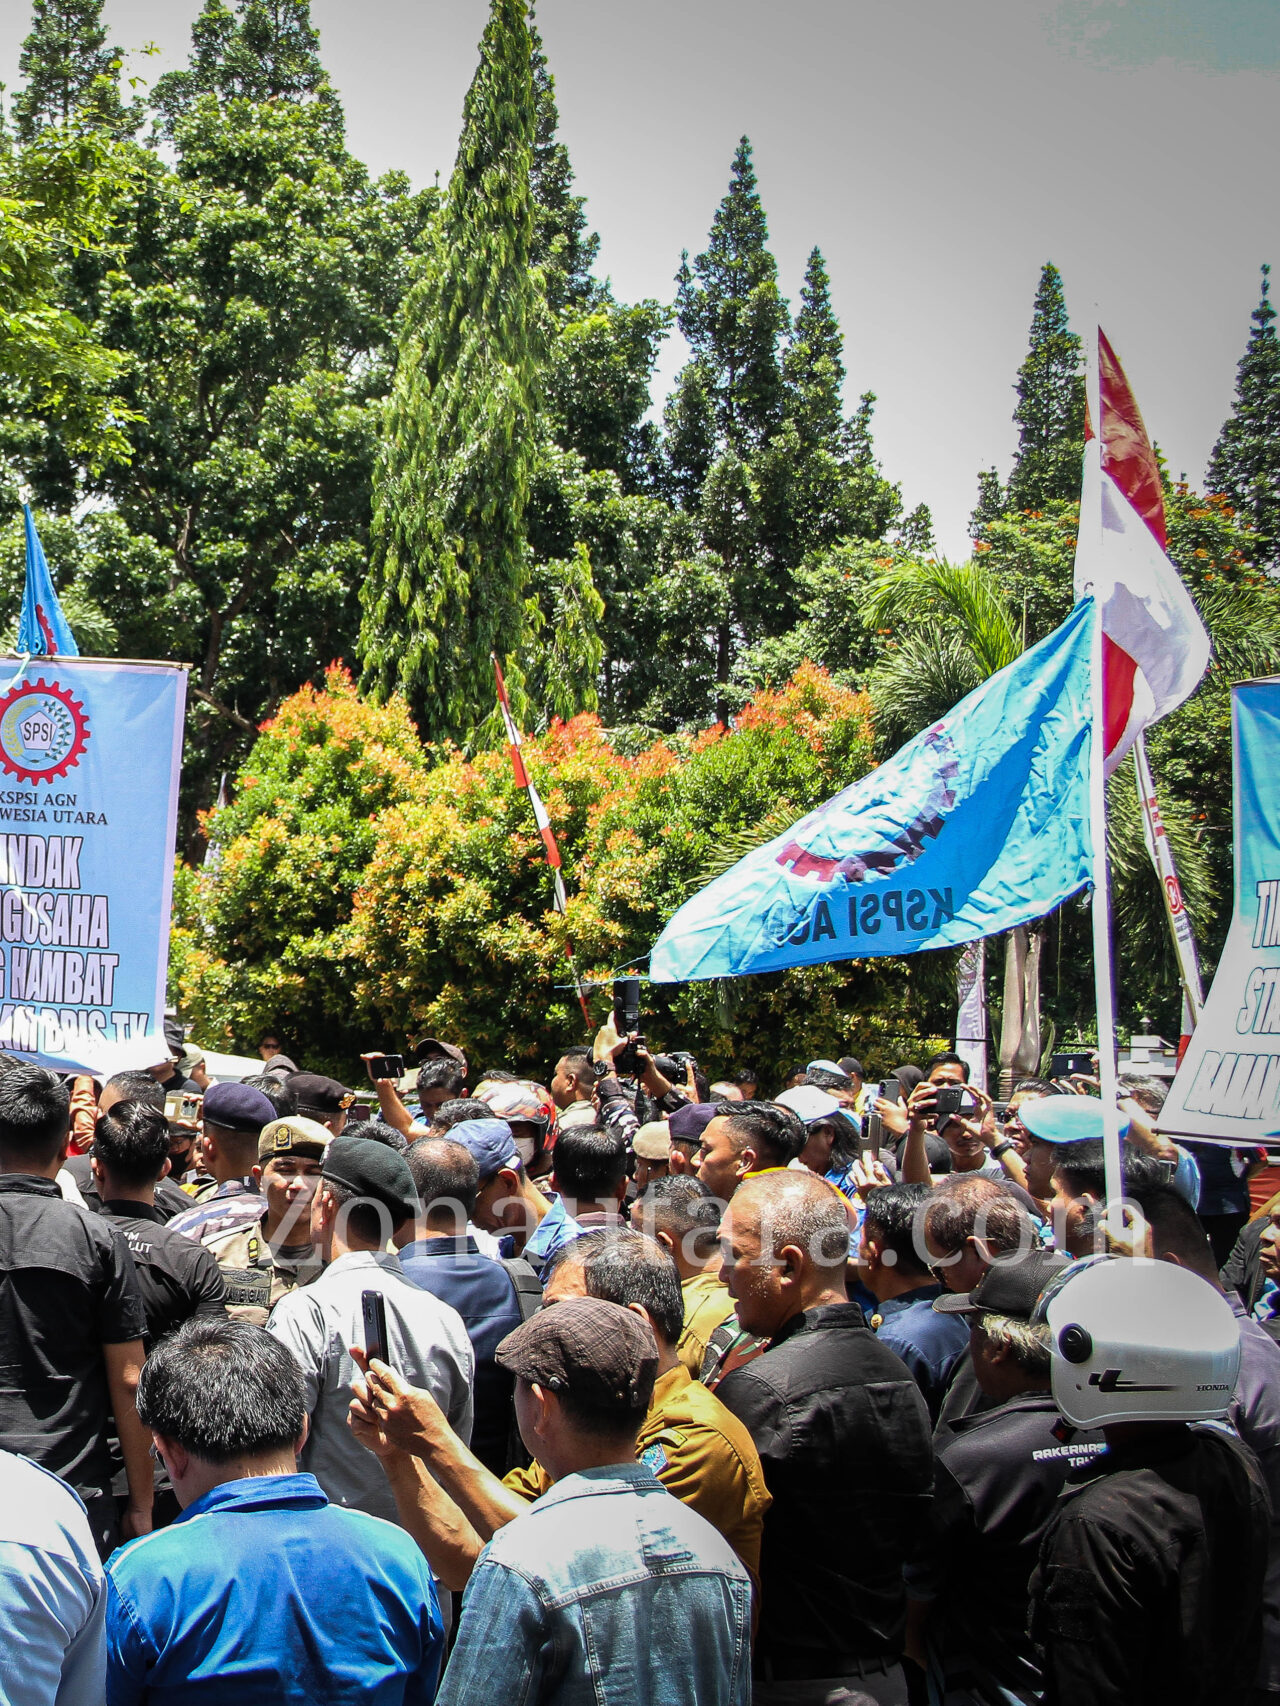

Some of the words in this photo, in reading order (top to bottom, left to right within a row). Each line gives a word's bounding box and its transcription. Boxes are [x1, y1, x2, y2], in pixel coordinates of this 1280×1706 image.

[23, 721, 54, 743] SPSI
[44, 792, 77, 806] AGN
[53, 809, 109, 826] UTARA
[10, 946, 120, 1006] HAMBAT
[128, 1241, 153, 1254] LUT
[1195, 1384, 1230, 1392] HONDA
